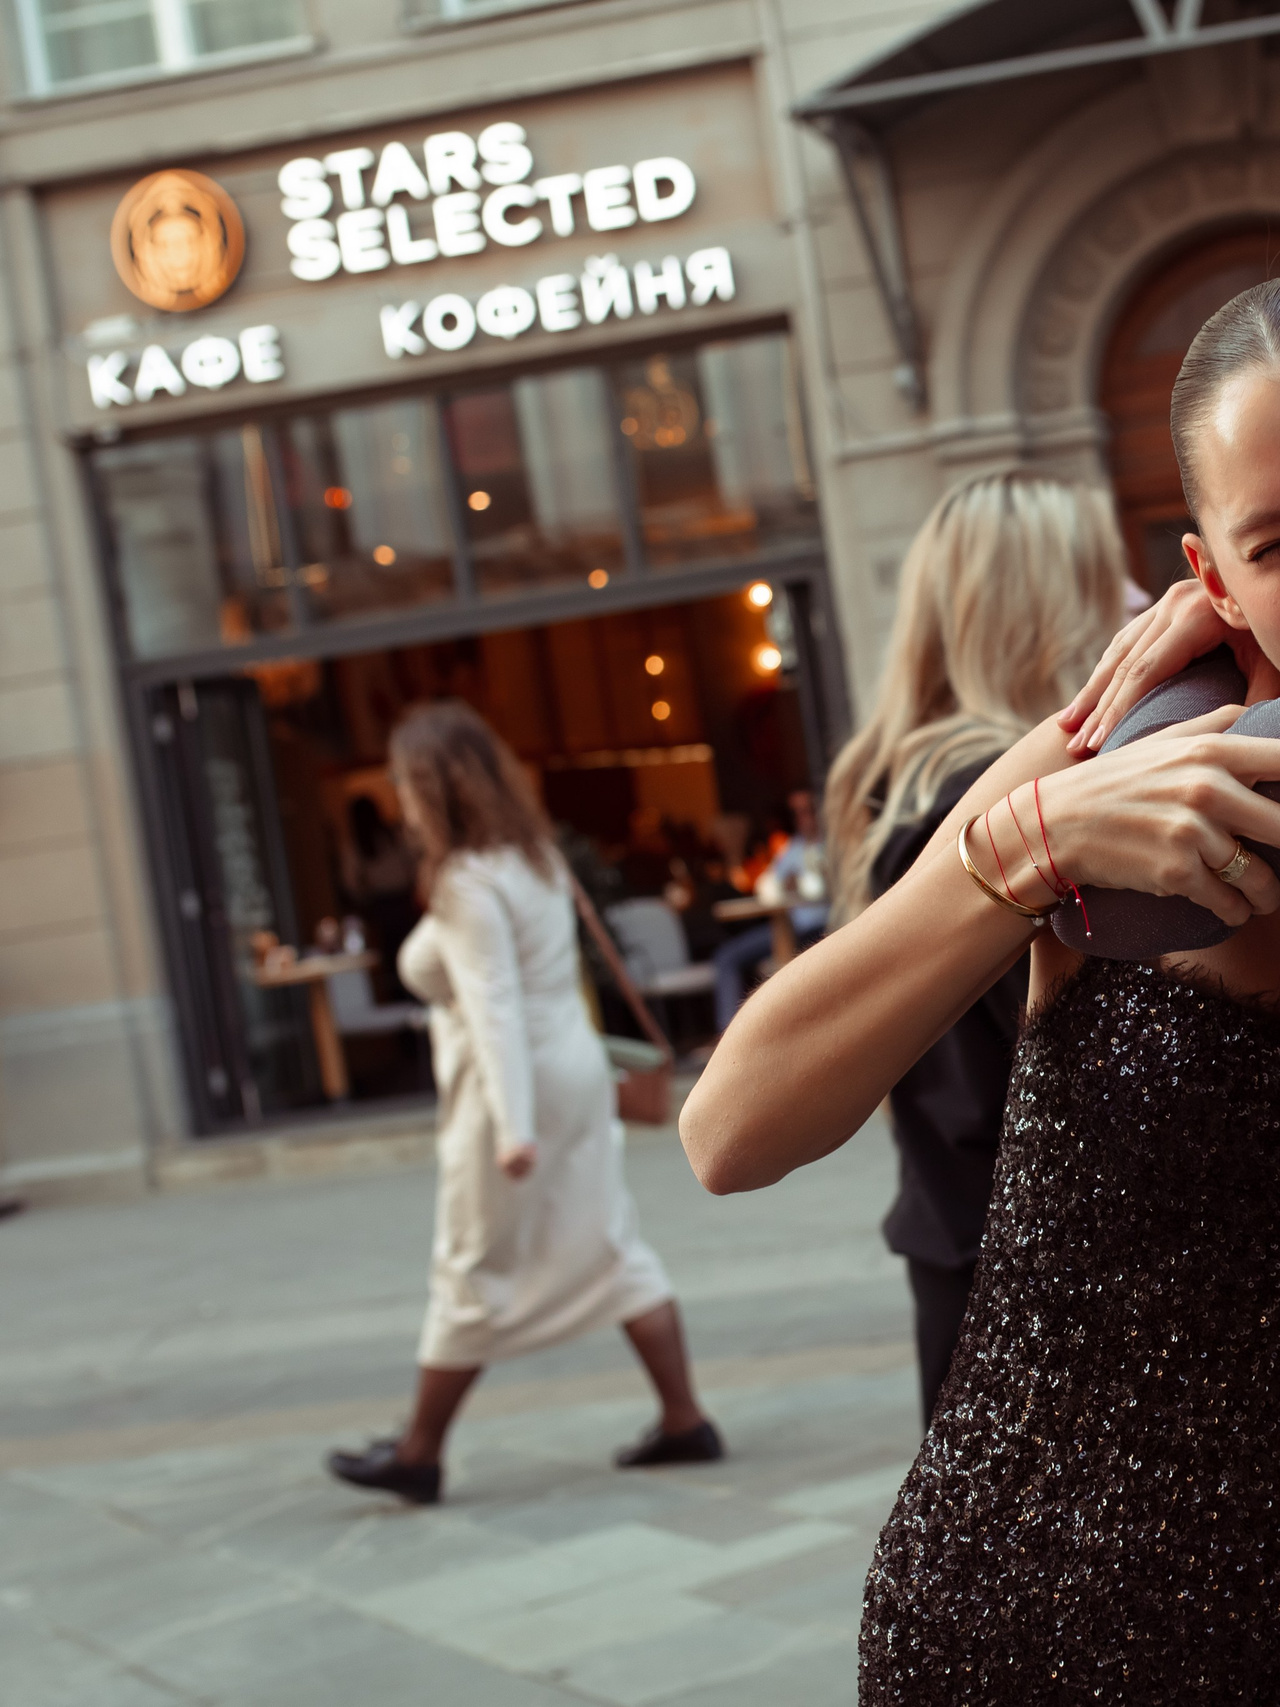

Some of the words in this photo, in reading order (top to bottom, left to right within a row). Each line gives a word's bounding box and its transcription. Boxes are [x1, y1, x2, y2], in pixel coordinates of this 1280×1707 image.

[278, 122, 533, 220] STARS
[287, 157, 696, 281] SELECTED
[87, 325, 284, 409] КАФЕ
[380, 246, 735, 358] КОФЕЙНЯ
